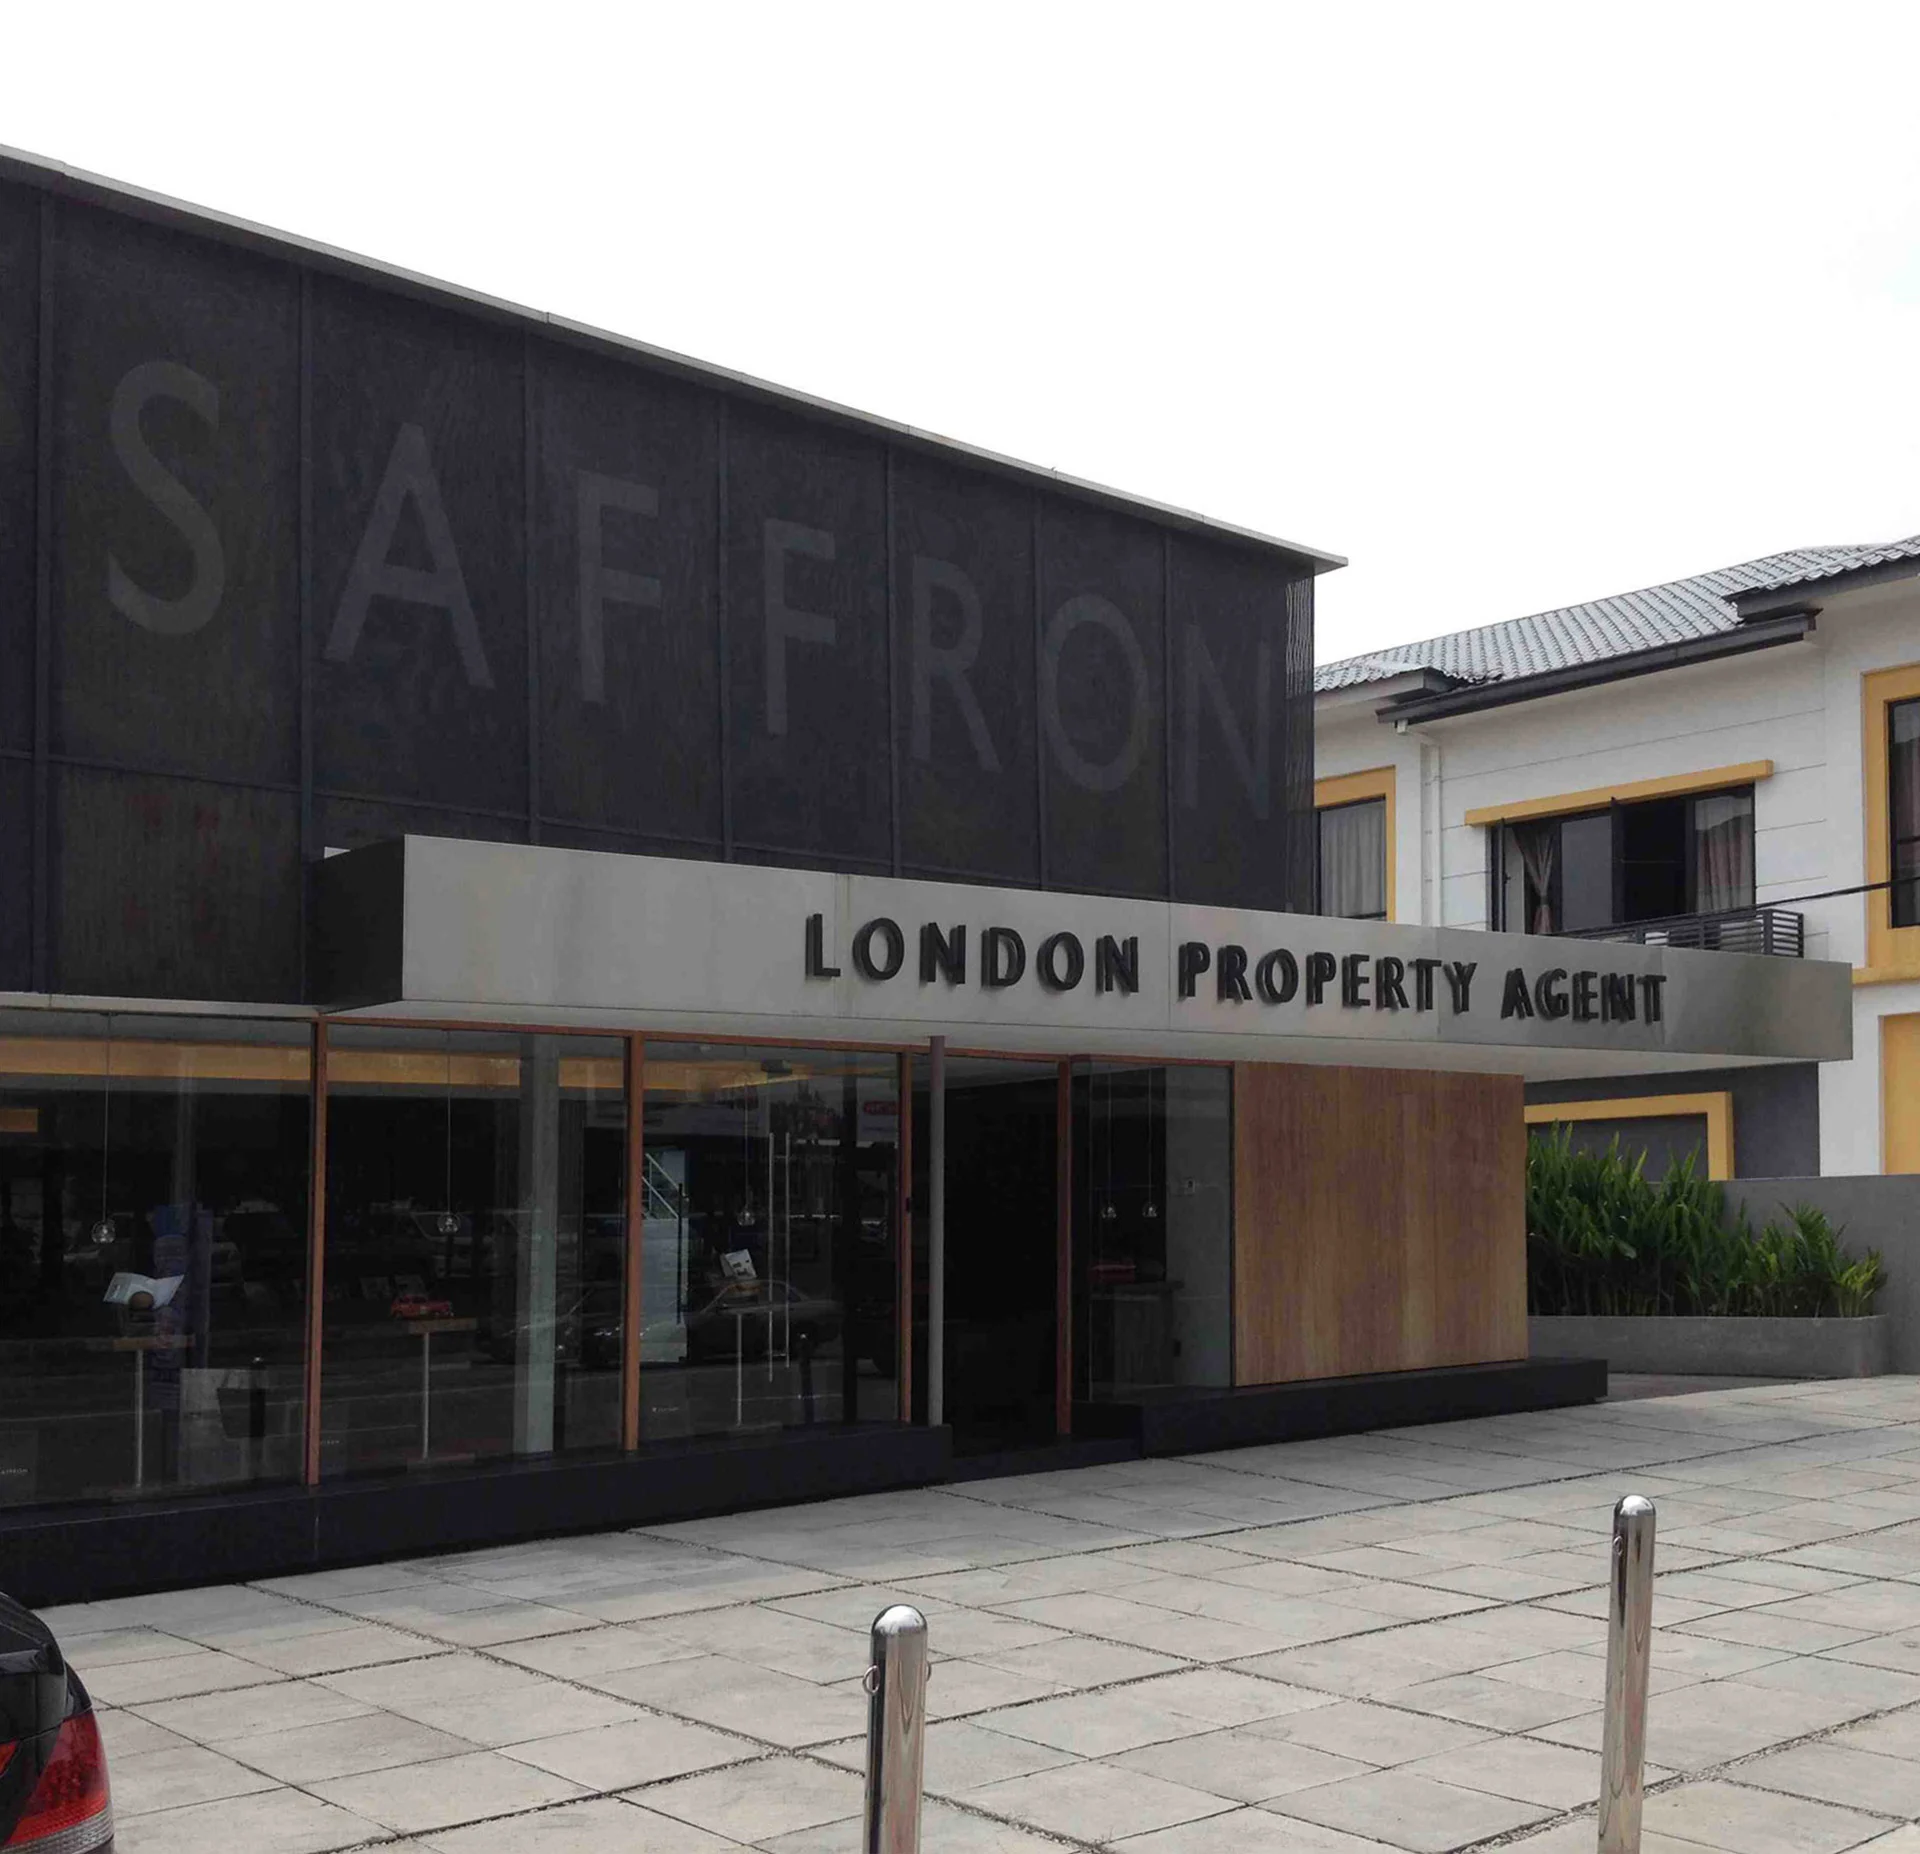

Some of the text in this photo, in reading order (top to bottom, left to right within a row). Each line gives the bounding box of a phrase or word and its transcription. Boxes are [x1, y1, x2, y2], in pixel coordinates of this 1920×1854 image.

[106, 360, 1273, 820] SAFFRON
[805, 913, 1667, 1024] LONDON PROPERTY AGENT
